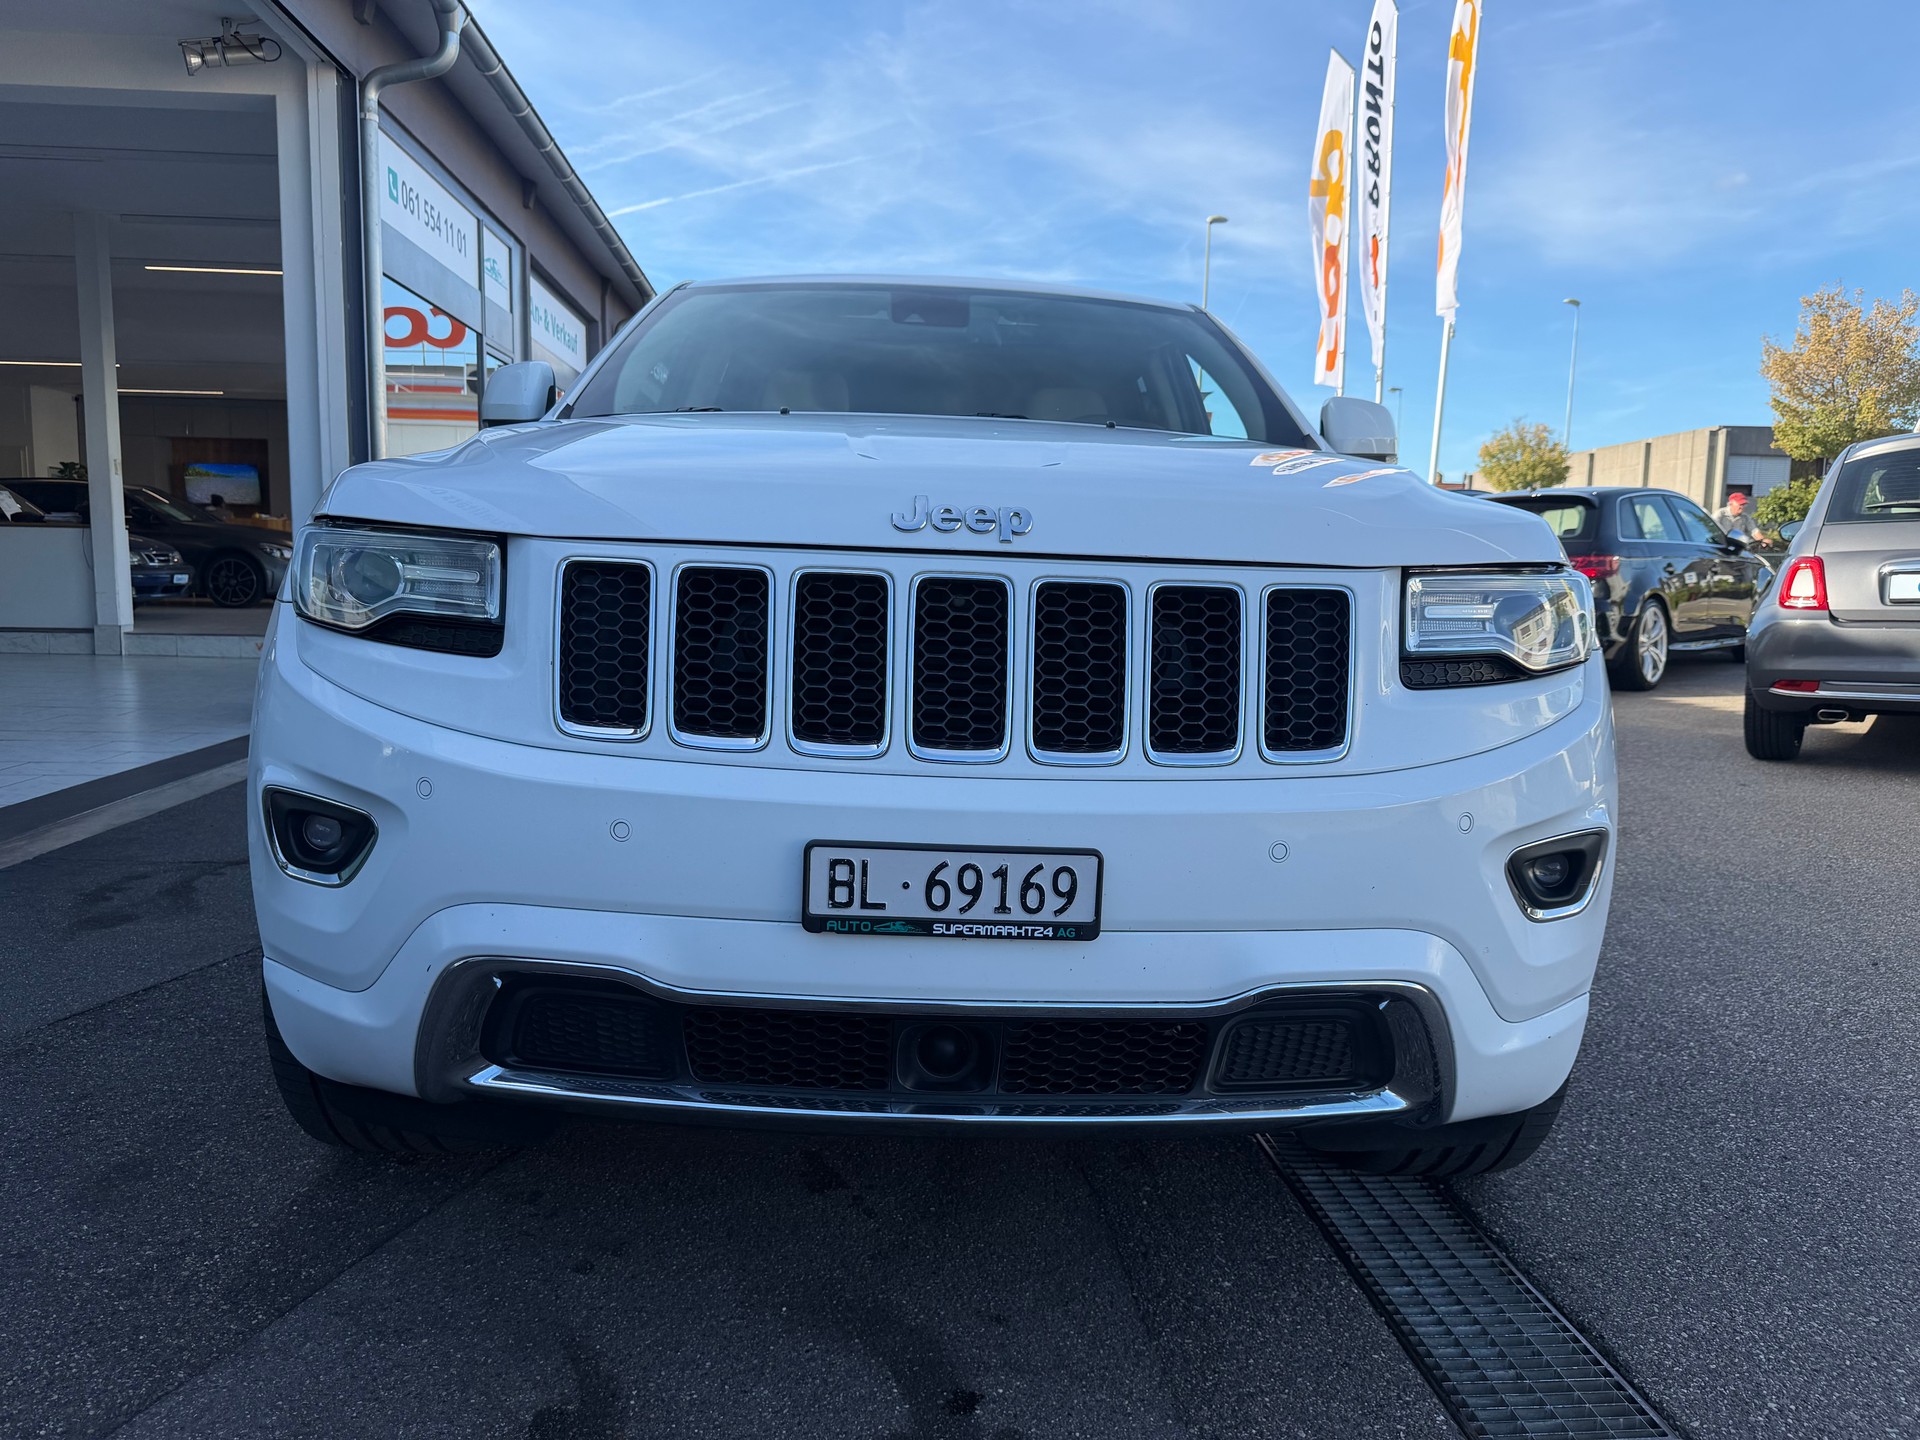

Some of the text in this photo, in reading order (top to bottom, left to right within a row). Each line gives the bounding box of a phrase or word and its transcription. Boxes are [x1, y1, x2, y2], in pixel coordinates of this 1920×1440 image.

[401, 180, 468, 258] 061 554 11 01
[543, 307, 551, 334] &
[550, 312, 578, 356] Verkauf
[890, 494, 1034, 544] Jeep
[828, 857, 887, 910] BL
[925, 859, 1079, 918] 69169
[826, 920, 1077, 939] AUTO SUPERMARKT24 AG
